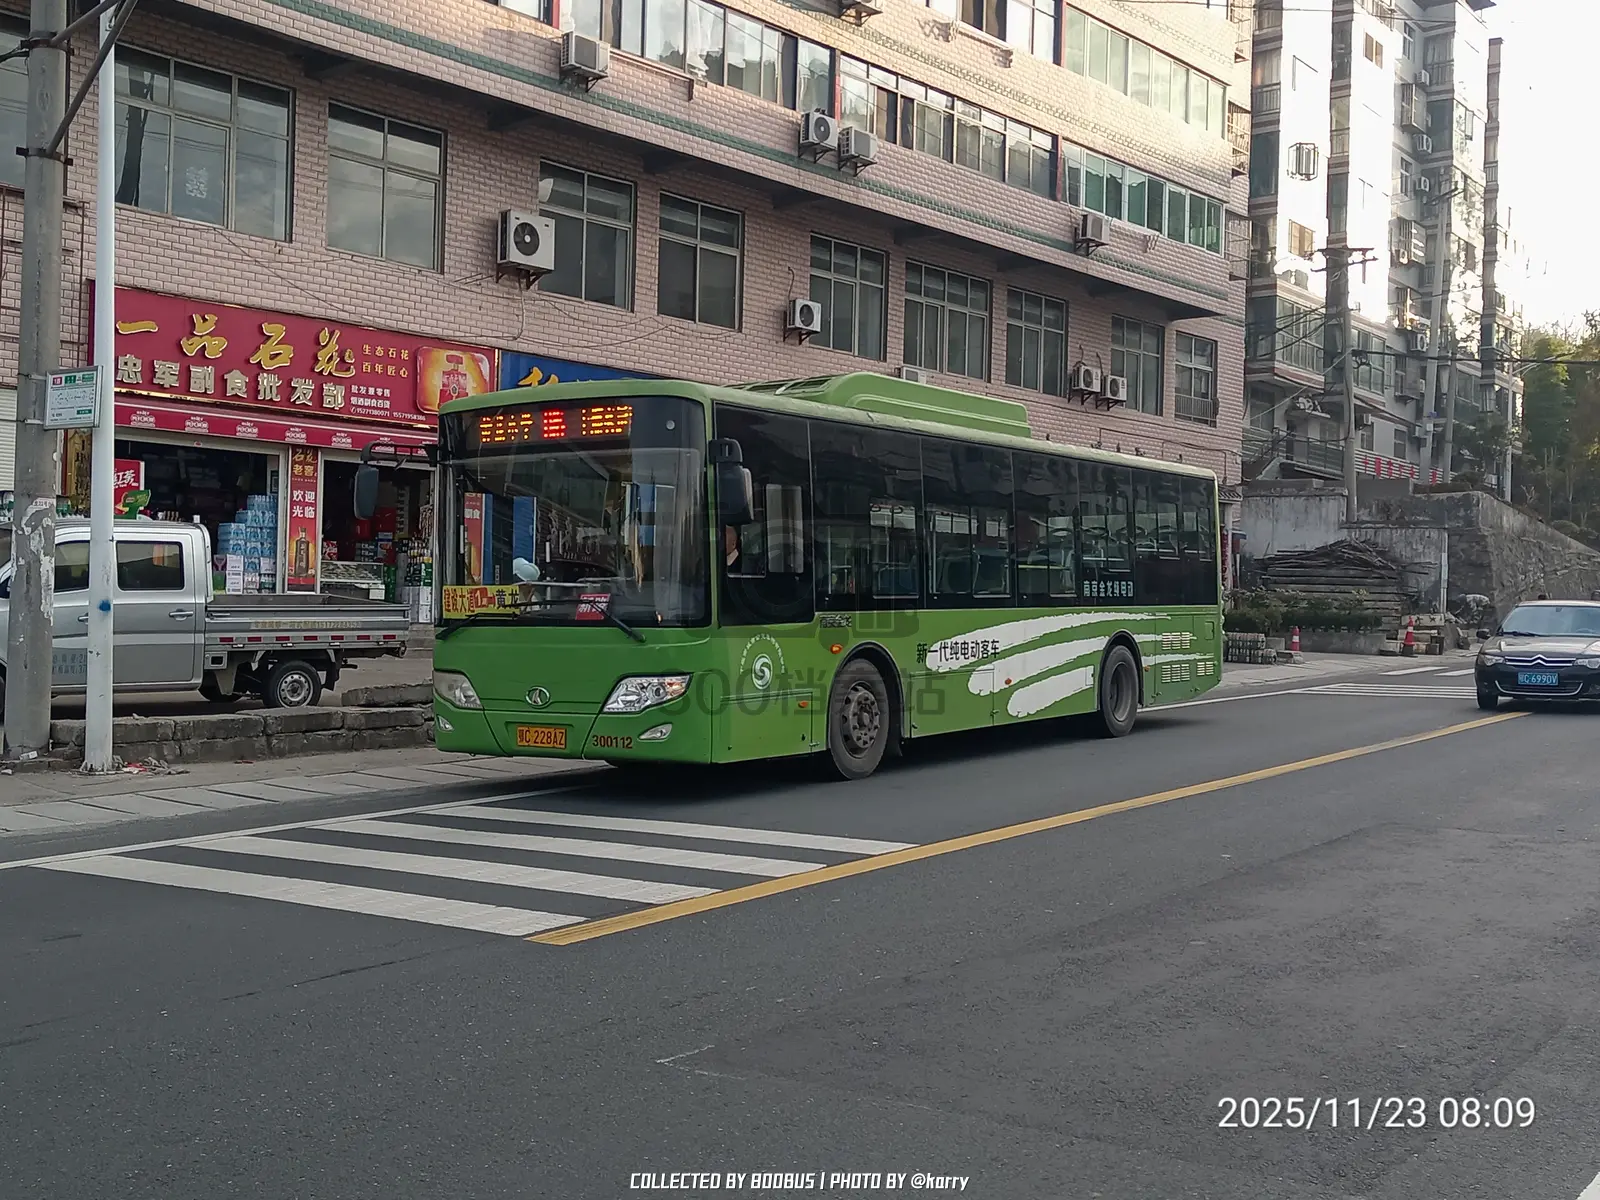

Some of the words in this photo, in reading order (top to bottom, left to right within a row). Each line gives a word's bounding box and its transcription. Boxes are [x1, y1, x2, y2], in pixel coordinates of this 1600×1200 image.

[363, 344, 409, 360] 生态石花
[363, 361, 408, 378] 百年匠心
[116, 354, 346, 410] 忠军副食批发部
[351, 384, 391, 398] 批发兼零售
[292, 490, 316, 503] 欢迎
[292, 505, 315, 518] 光临
[1083, 580, 1133, 597] 南京金龙纯电动
[916, 639, 999, 664] 新一代纯电动客车
[592, 735, 633, 749] 300112
